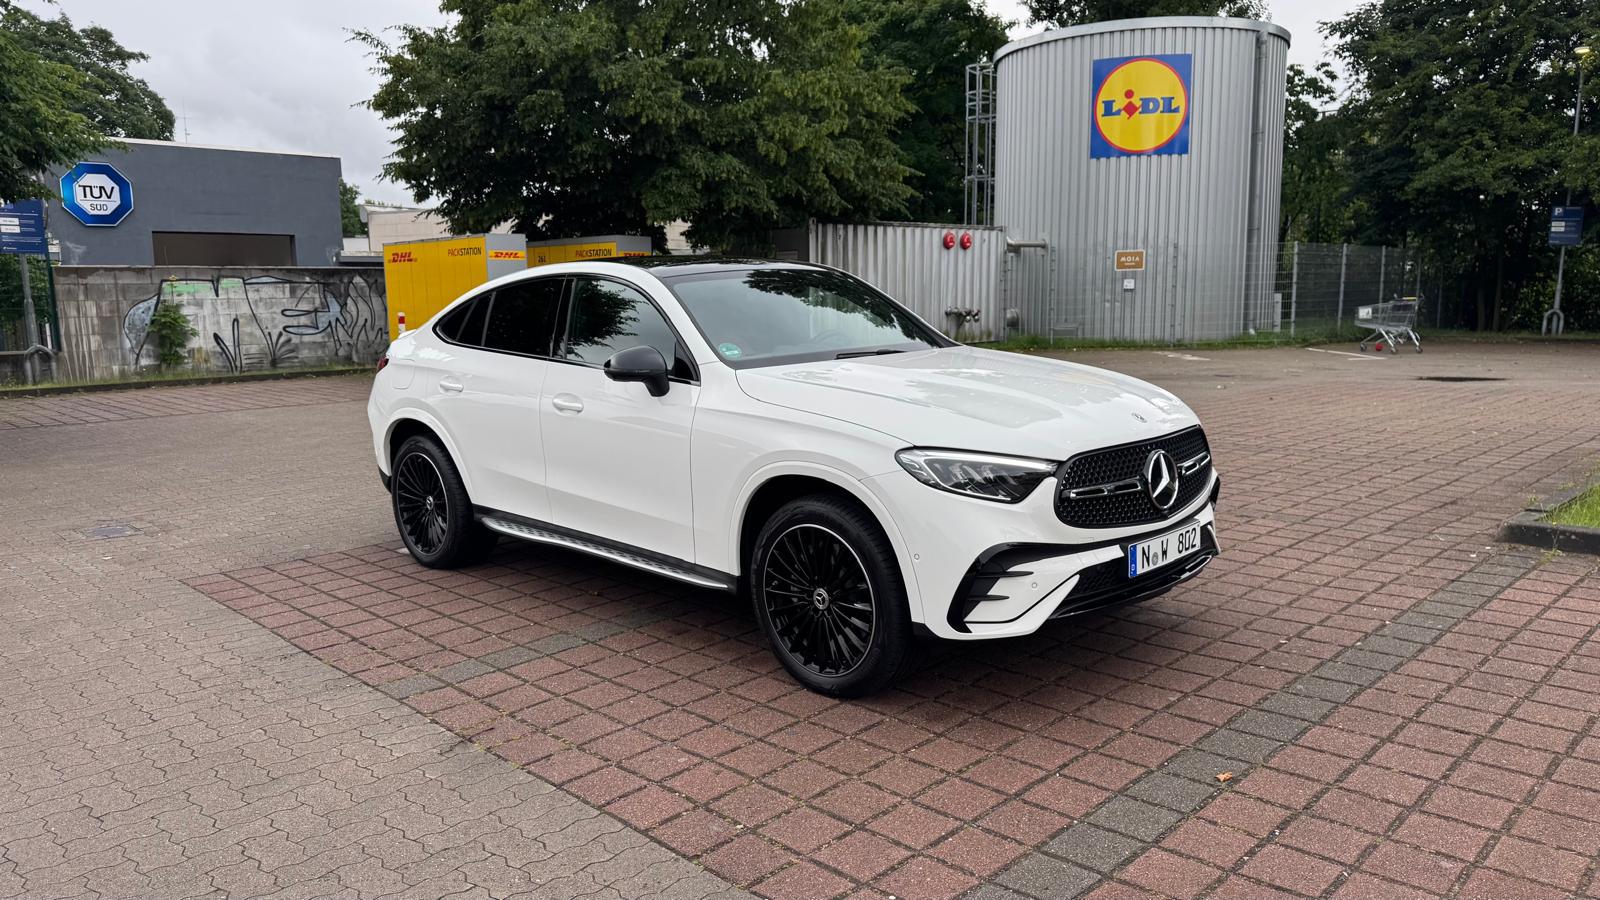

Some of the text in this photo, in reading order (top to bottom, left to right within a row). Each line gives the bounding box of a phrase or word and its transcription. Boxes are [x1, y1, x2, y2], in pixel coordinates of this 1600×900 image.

[78, 184, 115, 200] TÜV
[1555, 208, 1563, 216] P
[391, 251, 414, 263] DHL
[447, 247, 482, 256] PACKSTATION
[575, 248, 613, 258] PACKSTATION
[1141, 527, 1197, 569] N W 802
